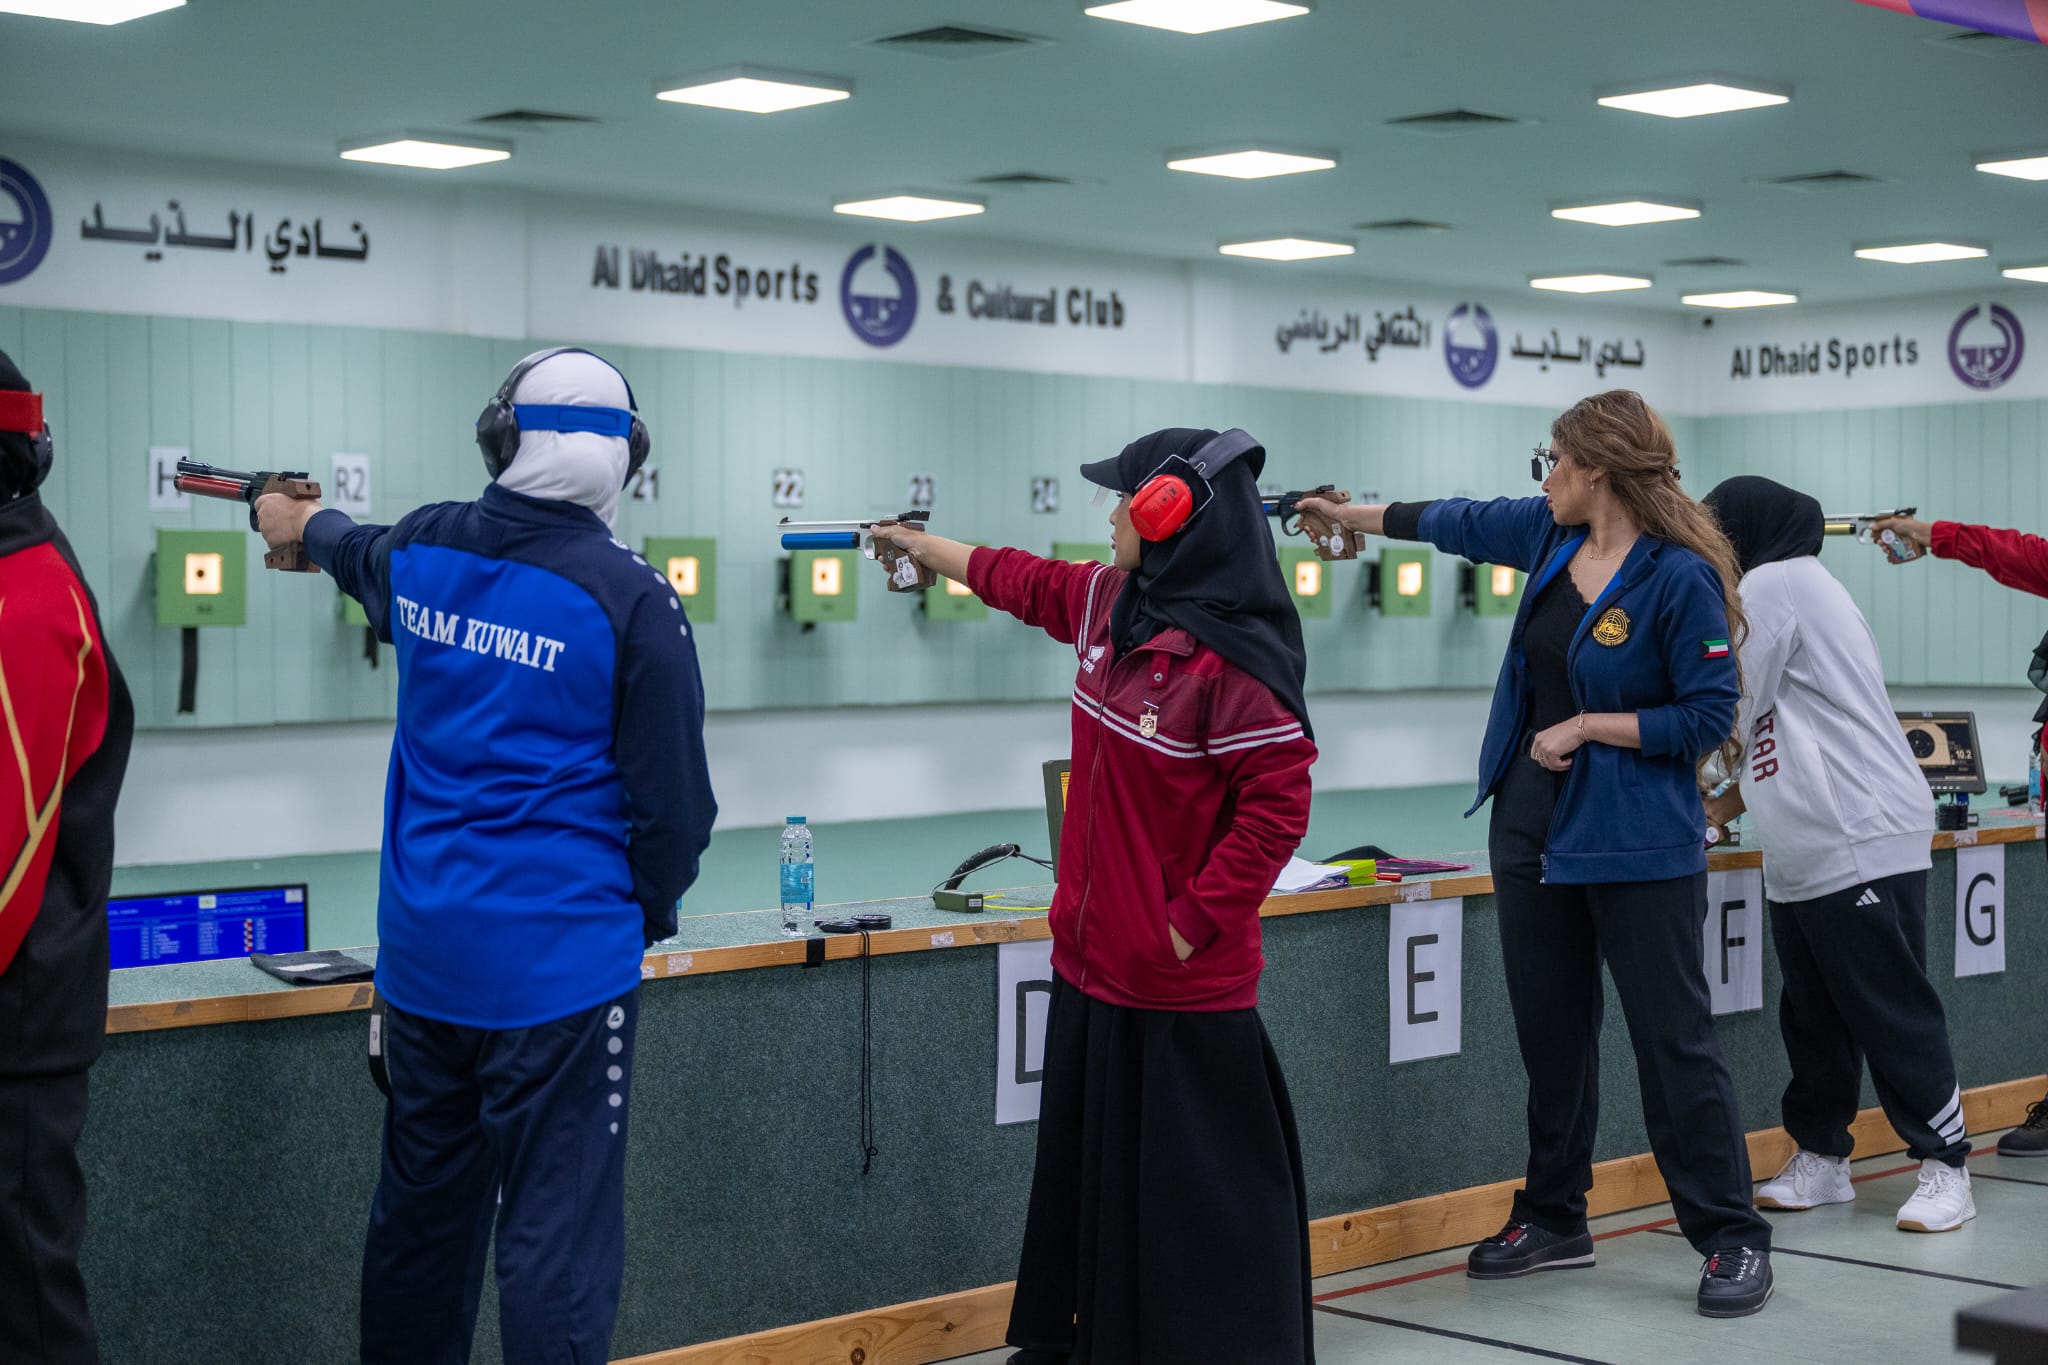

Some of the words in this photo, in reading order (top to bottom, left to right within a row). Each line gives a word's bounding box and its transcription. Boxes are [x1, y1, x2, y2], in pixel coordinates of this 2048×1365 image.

[80, 199, 254, 261] الذيد
[265, 217, 370, 274] نادي
[592, 243, 620, 289] Al
[628, 247, 706, 297] Dhaid
[713, 253, 819, 308] Sports
[936, 274, 955, 315] &
[966, 279, 1058, 325] Cultural
[1066, 284, 1125, 328] Club
[1730, 347, 1751, 380] Al
[1758, 344, 1820, 377] Dhaid
[1827, 335, 1919, 378] Sports
[334, 467, 366, 502] R2
[396, 595, 460, 646] TEAM
[461, 618, 566, 672] KUWAIT
[1752, 709, 1779, 783] TAR
[1955, 748, 1973, 760] 10.2
[1720, 899, 1746, 985] F
[1964, 872, 1997, 946] G
[1406, 933, 1439, 1025] E
